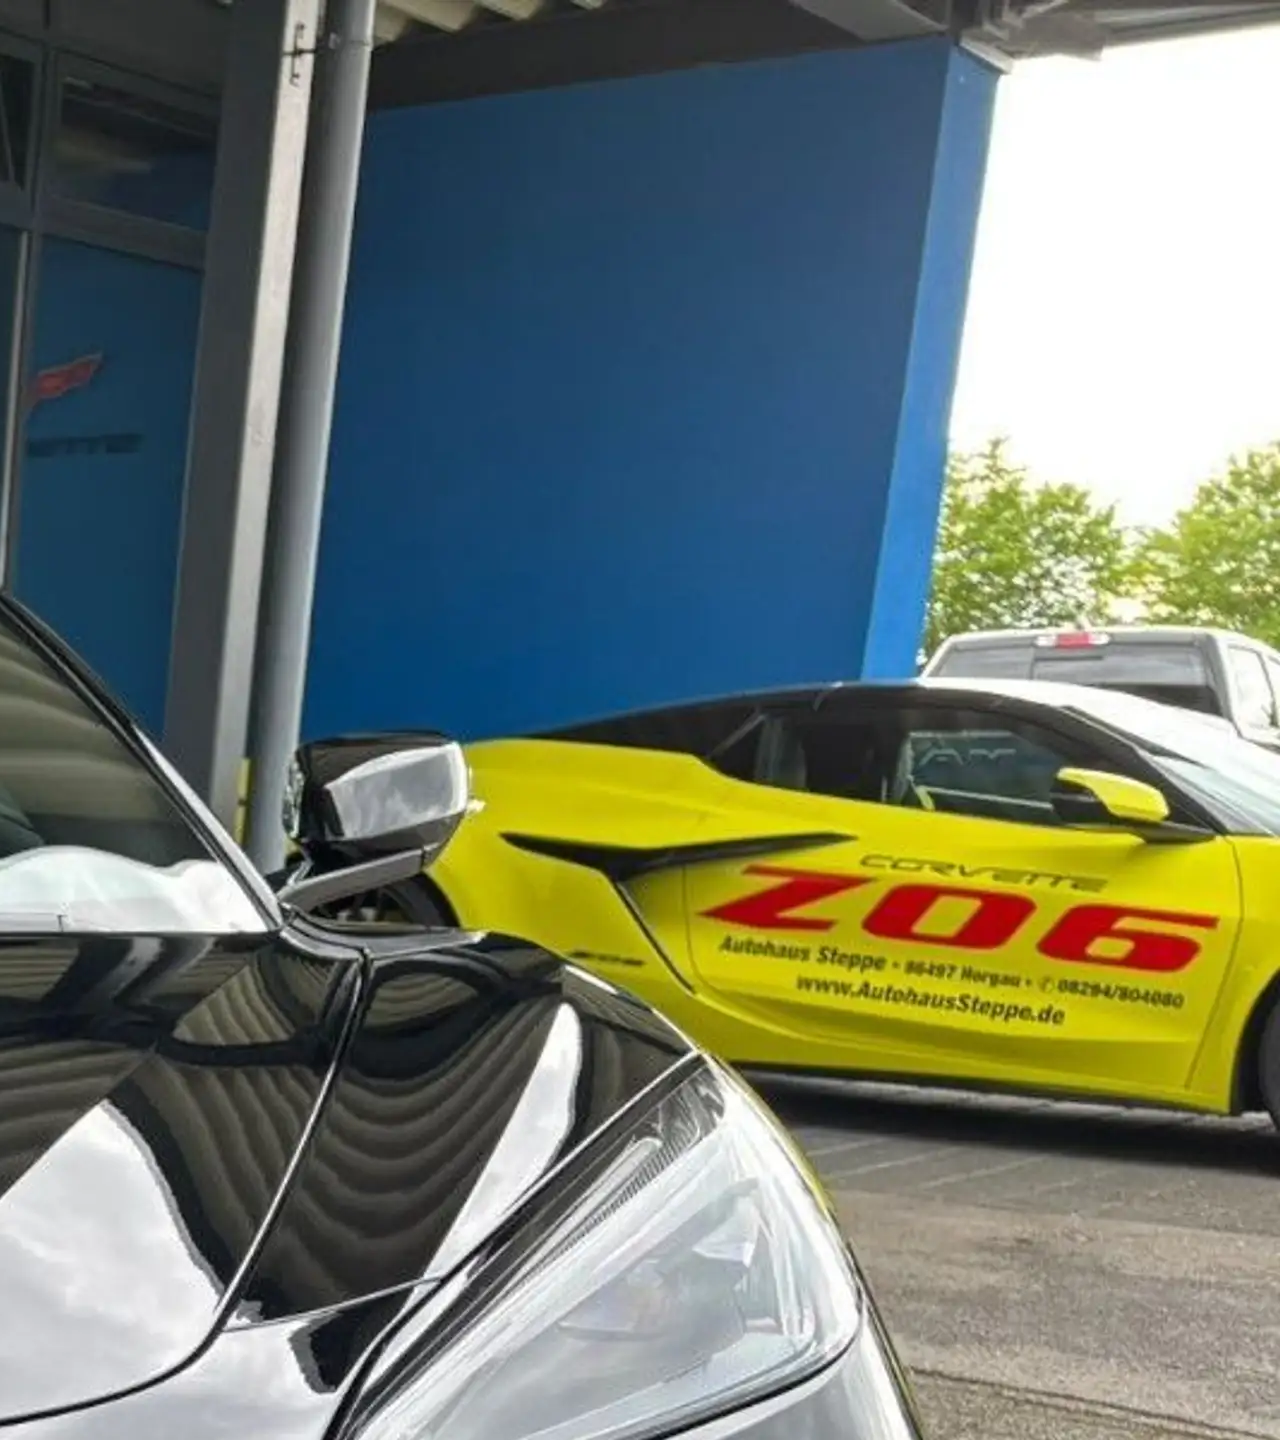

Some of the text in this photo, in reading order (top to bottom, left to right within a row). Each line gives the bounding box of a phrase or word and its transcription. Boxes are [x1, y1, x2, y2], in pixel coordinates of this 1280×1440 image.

[859, 854, 1109, 893] CORVETTE
[696, 864, 1220, 973] Z06
[719, 934, 810, 962] Autohaus
[816, 945, 887, 974] Steppe
[796, 974, 1066, 1026] www.AutohausSteppe.de
